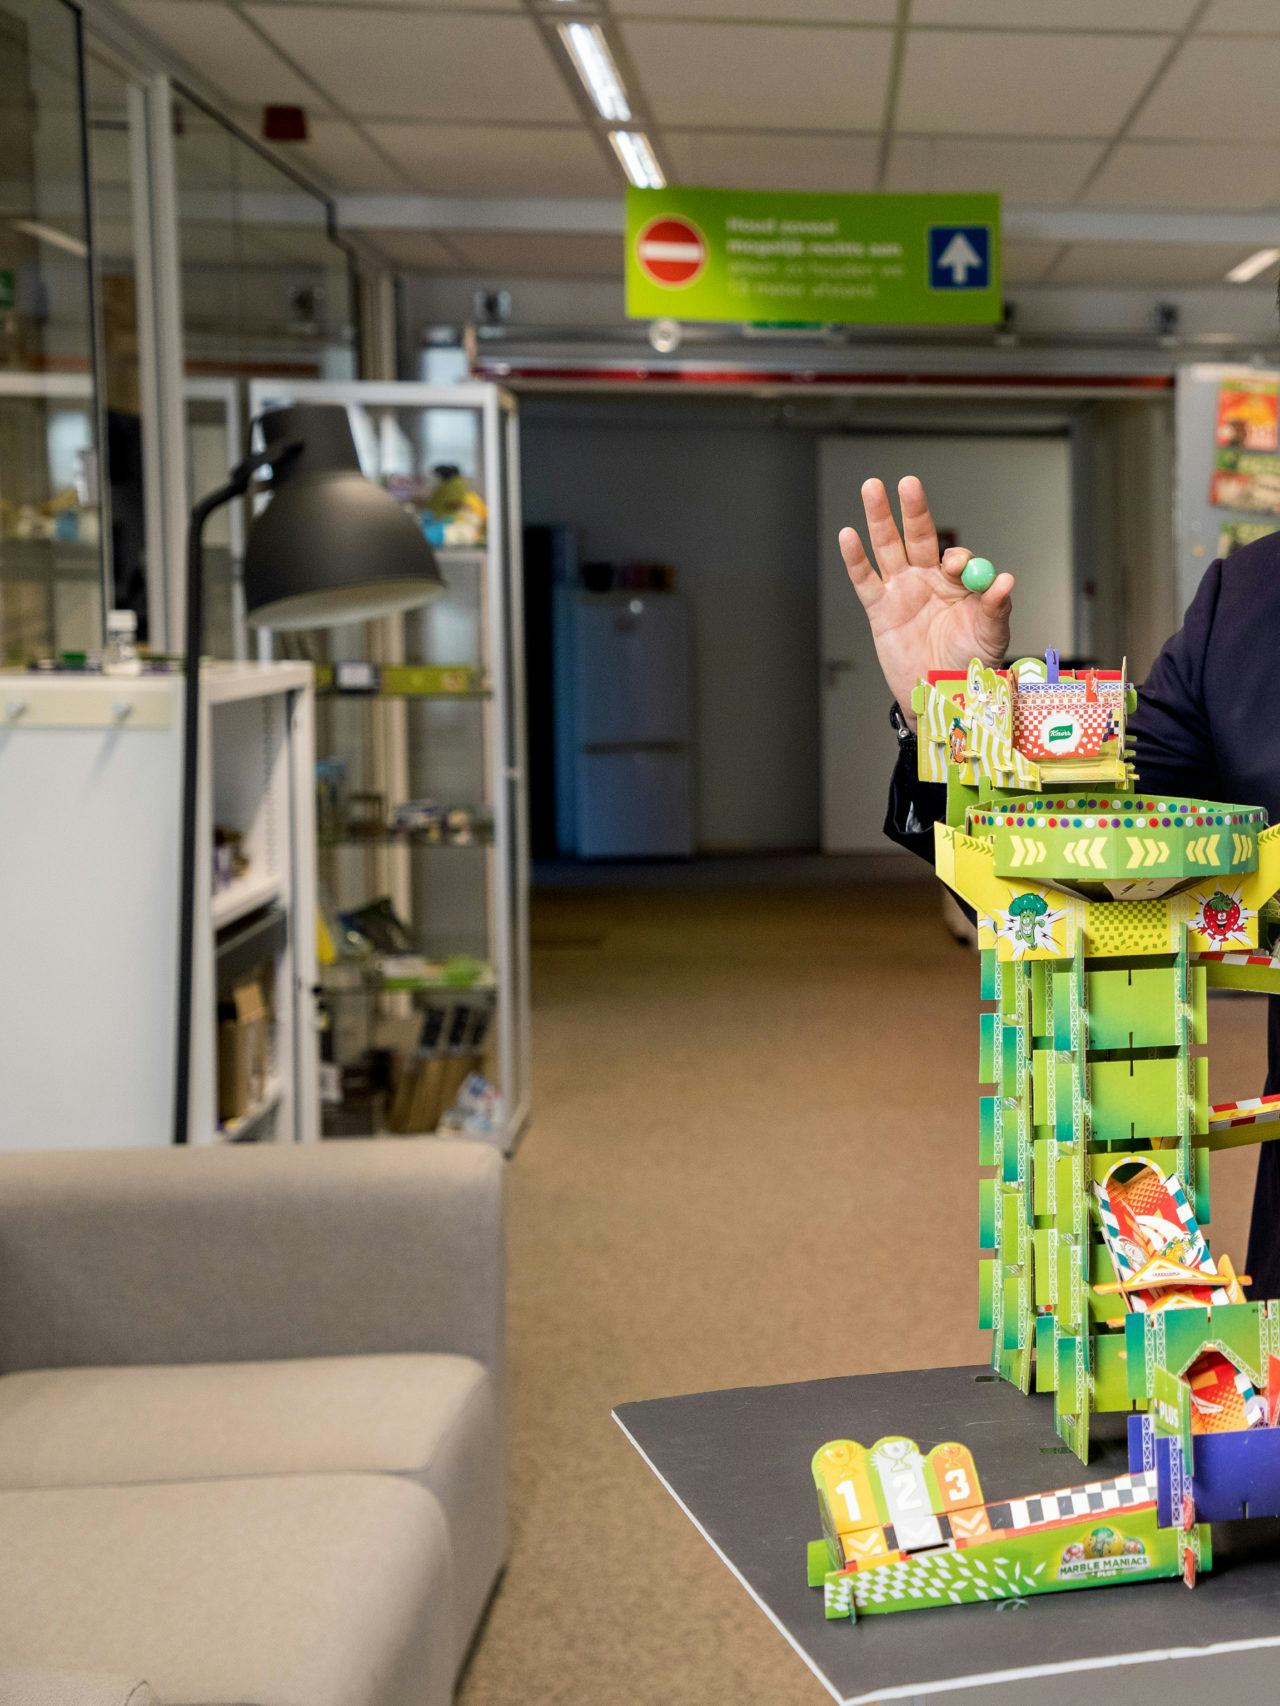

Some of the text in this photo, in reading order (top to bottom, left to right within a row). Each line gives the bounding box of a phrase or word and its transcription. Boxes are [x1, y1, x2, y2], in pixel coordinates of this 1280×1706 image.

[1159, 1400, 1179, 1428] PLUS
[835, 1468, 971, 1521] 1 2 3
[1059, 1556, 1148, 1575] MARBLE MANIACS
